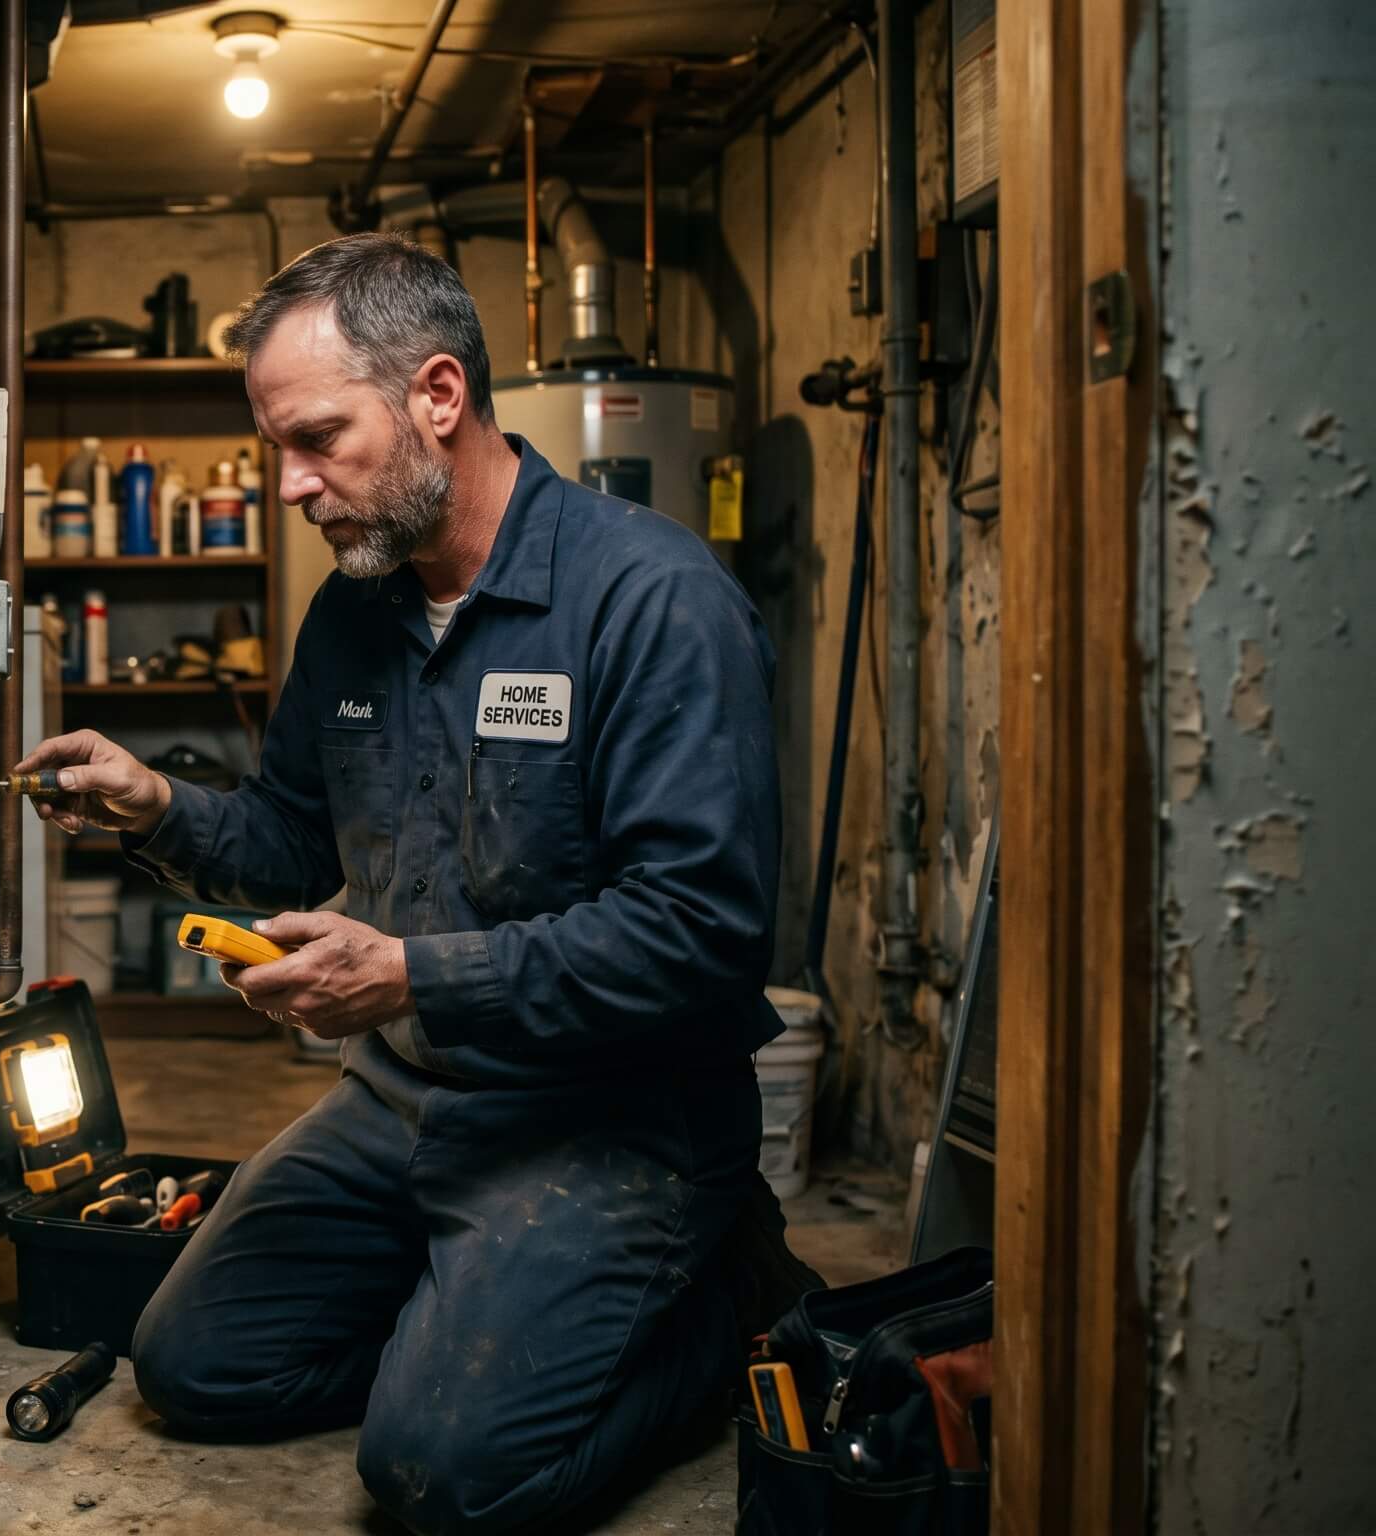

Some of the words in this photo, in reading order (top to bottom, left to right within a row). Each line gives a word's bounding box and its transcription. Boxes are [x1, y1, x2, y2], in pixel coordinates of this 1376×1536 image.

[500, 685, 548, 704] HOME
[337, 700, 373, 719] Mark
[483, 706, 564, 728] SERVICES
